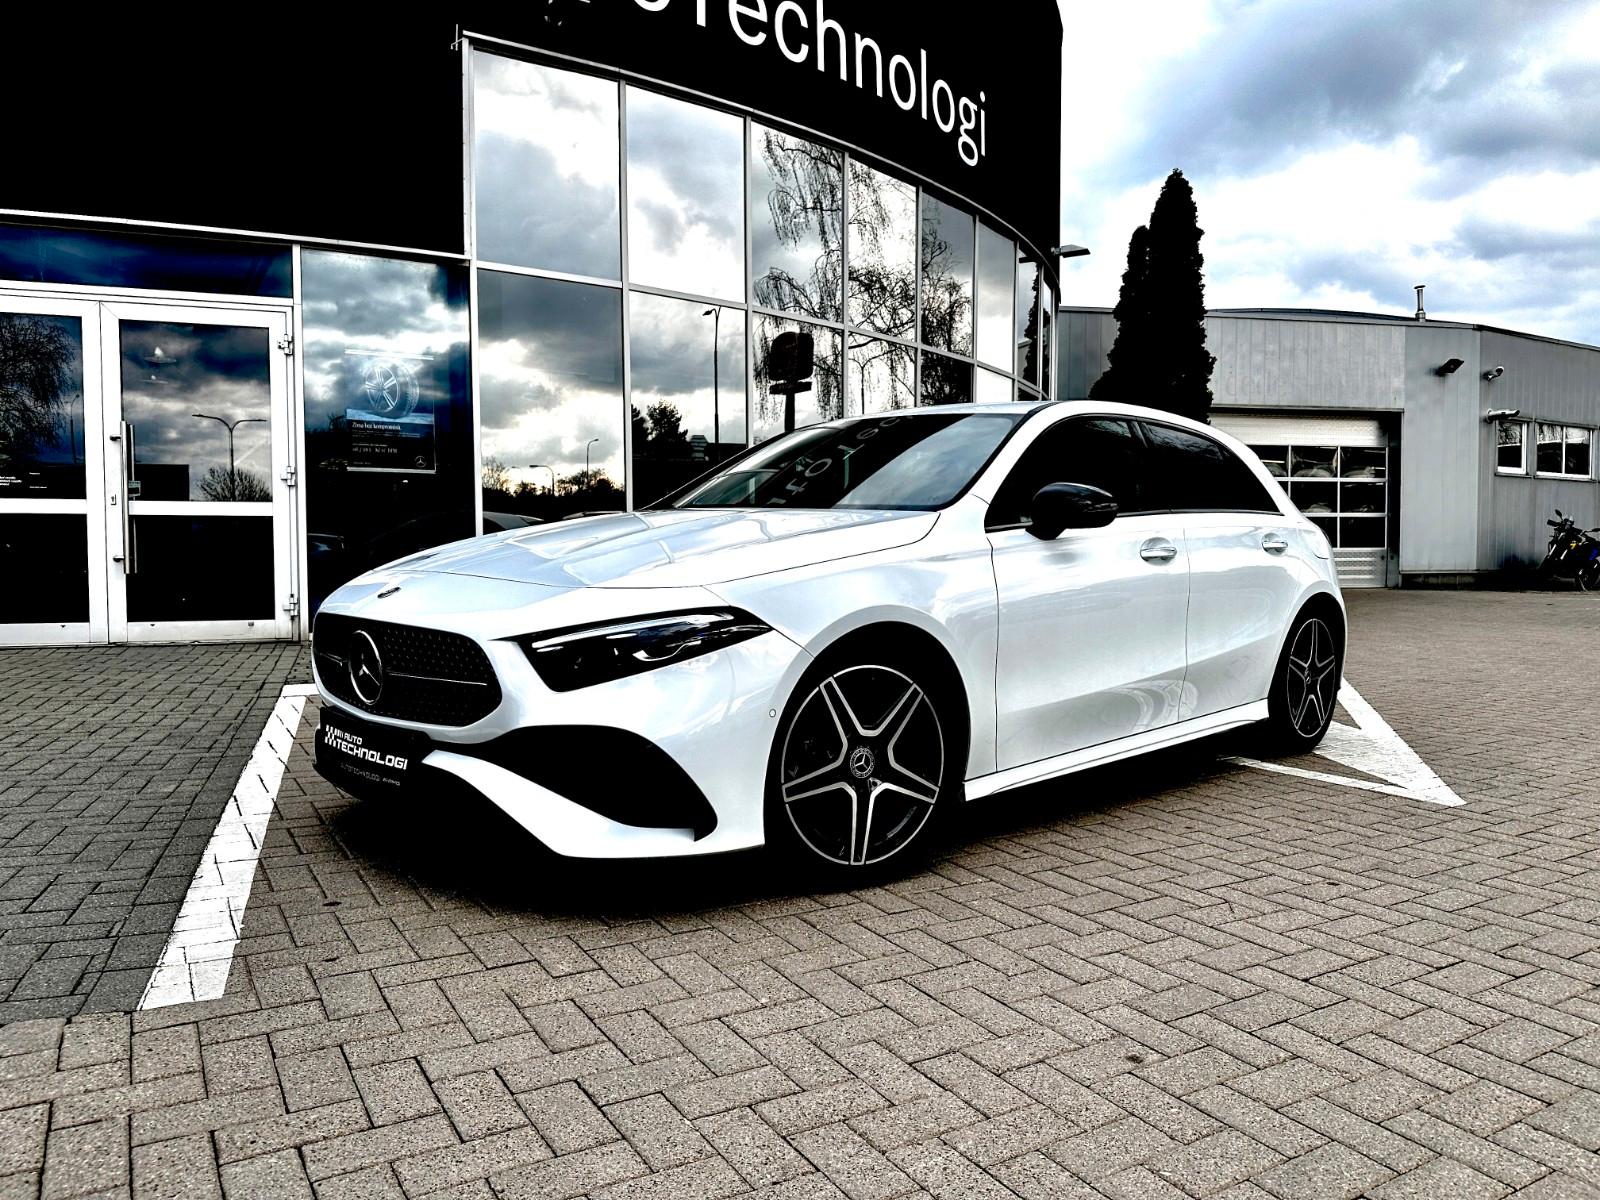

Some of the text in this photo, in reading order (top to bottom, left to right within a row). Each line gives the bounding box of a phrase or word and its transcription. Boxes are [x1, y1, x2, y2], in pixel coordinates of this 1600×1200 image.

[580, 0, 986, 166] echnologi
[336, 738, 409, 770] TECHNOLOGI
[344, 732, 363, 746] AUTO
